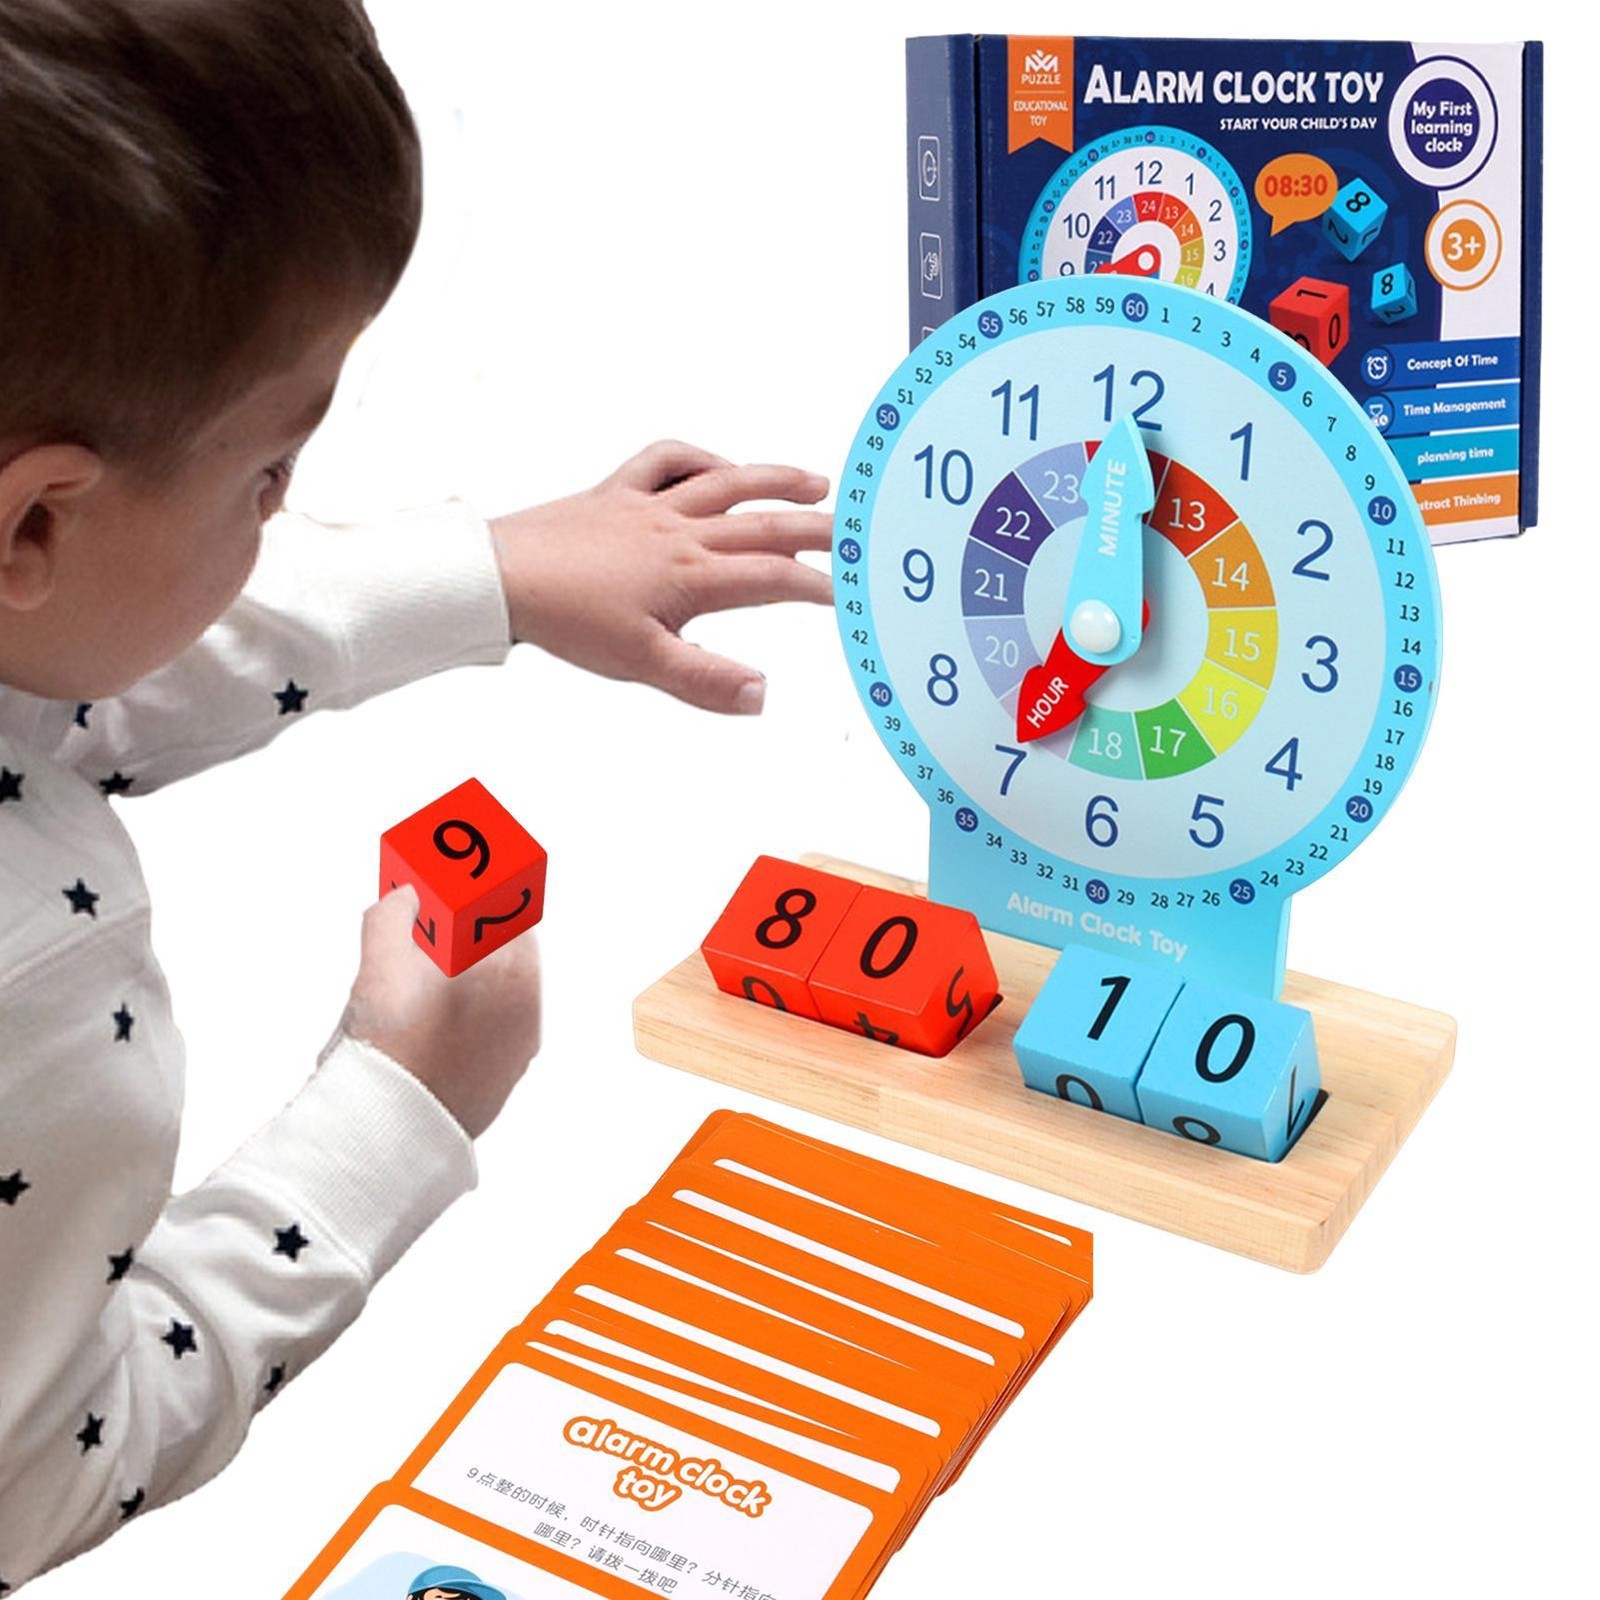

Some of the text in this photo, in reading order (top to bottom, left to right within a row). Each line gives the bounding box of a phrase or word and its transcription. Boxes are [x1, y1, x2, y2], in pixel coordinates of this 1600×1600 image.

[1021, 73, 1061, 85] PUZZLE
[1084, 65, 1384, 104] ALARM CLOCK TOY
[1014, 100, 1068, 112] EDUCATIONAL
[1412, 101, 1472, 117] My First
[1030, 116, 1047, 126] TOY
[1220, 118, 1377, 130] START YOUR CHILD'S DAY
[1411, 120, 1472, 136] learning
[1425, 138, 1462, 152] clock
[1135, 160, 1163, 185] 12
[1095, 176, 1115, 200] 11
[1185, 173, 1194, 195] 1
[1264, 174, 1328, 197] 08:30
[1141, 200, 1156, 213] 24
[1346, 192, 1371, 212] 8
[1117, 210, 1132, 224] 23
[1164, 207, 1178, 219] 13
[1209, 200, 1222, 222] 2
[1063, 212, 1090, 239] 10
[1181, 224, 1194, 236] 14
[1098, 231, 1113, 245] 22
[1214, 239, 1226, 261] 3
[1447, 233, 1481, 260] 3+
[1186, 249, 1199, 262] 15
[1381, 273, 1394, 295] 8
[1036, 301, 1055, 317] 57
[1066, 297, 1085, 314] 58
[1096, 297, 1114, 314] 59
[1126, 300, 1145, 318] 60
[1009, 309, 1027, 325] 56
[1161, 307, 1170, 323] 1
[981, 316, 998, 333] 55
[1192, 316, 1201, 333] 2
[1329, 313, 1341, 348] 0
[958, 334, 976, 350] 54
[1221, 331, 1231, 347] 3
[935, 350, 953, 366] 53
[1250, 348, 1260, 362] 4
[1407, 354, 1498, 370] Concept Of Time
[915, 368, 932, 384] 52
[1276, 368, 1287, 386] 5
[898, 389, 913, 405] 51
[1093, 364, 1165, 431] 12
[1303, 391, 1312, 407] 6
[991, 379, 1039, 441] 11
[1404, 399, 1506, 415] Time Management
[879, 409, 896, 426] 50
[1327, 416, 1337, 432] 7
[866, 435, 884, 450] 49
[1230, 421, 1253, 481] 1
[1346, 445, 1356, 461] 8
[1418, 447, 1494, 465] planning time
[856, 462, 873, 477] 48
[914, 444, 974, 506] 10
[1043, 471, 1079, 504] 23
[1365, 475, 1375, 490] 9
[849, 489, 866, 503] 47
[1454, 494, 1501, 507] Thinking
[1098, 459, 1127, 557] MINUTE
[1168, 498, 1205, 532] 13
[1372, 502, 1392, 520] 10
[845, 517, 862, 532] 46
[995, 506, 1031, 540] 22
[841, 544, 857, 560] 45
[1292, 519, 1334, 581] 2
[1386, 538, 1406, 556] 11
[842, 571, 859, 586] 44
[902, 548, 934, 603] 9
[1211, 557, 1249, 591] 14
[1394, 571, 1415, 590] 12
[974, 568, 1008, 601] 21
[846, 601, 862, 615] 43
[1399, 604, 1420, 622] 13
[851, 629, 868, 644] 42
[1223, 629, 1260, 660] 15
[985, 635, 1019, 668] 20
[1400, 639, 1421, 655] 14
[860, 659, 876, 673] 41
[1301, 635, 1339, 693] 3
[927, 653, 959, 706] 8
[1398, 670, 1417, 687] 15
[872, 688, 889, 702] 40
[1026, 676, 1069, 729] HOUR
[1201, 686, 1238, 720] 16
[1394, 700, 1413, 717] 16
[885, 716, 900, 731] 39
[1088, 728, 1123, 759] 18
[1150, 725, 1186, 757] 17
[1385, 729, 1405, 745] 17
[900, 741, 916, 757] 38
[995, 744, 1027, 796] 7
[1264, 737, 1303, 791] 4
[1375, 754, 1394, 771] 18
[917, 765, 933, 780] 37
[1363, 779, 1382, 795] 19
[937, 788, 954, 804] 36
[1350, 802, 1369, 818] 20
[959, 813, 975, 828] 35
[1085, 795, 1119, 848] 6
[1189, 794, 1224, 848] 5
[986, 833, 1002, 848] 34
[1331, 825, 1349, 841] 21
[1010, 850, 1027, 865] 33
[1309, 844, 1328, 860] 22
[1036, 864, 1054, 880] 32
[1285, 859, 1305, 876] 23
[1062, 876, 1078, 891] 31
[1260, 871, 1279, 887] 24
[1089, 885, 1106, 899] 30
[1117, 890, 1135, 906] 29
[1176, 892, 1194, 907] 27
[1202, 890, 1220, 906] 26
[1233, 885, 1251, 899] 25
[1151, 893, 1169, 908] 28
[755, 888, 817, 949] 8
[1007, 891, 1188, 962] Alarm Clock Toy
[859, 916, 918, 979] 0
[1087, 976, 1131, 1041] 1
[1195, 1014, 1256, 1083] 0
[566, 1417, 770, 1515] alarm clock
[618, 1470, 678, 1507] toy
